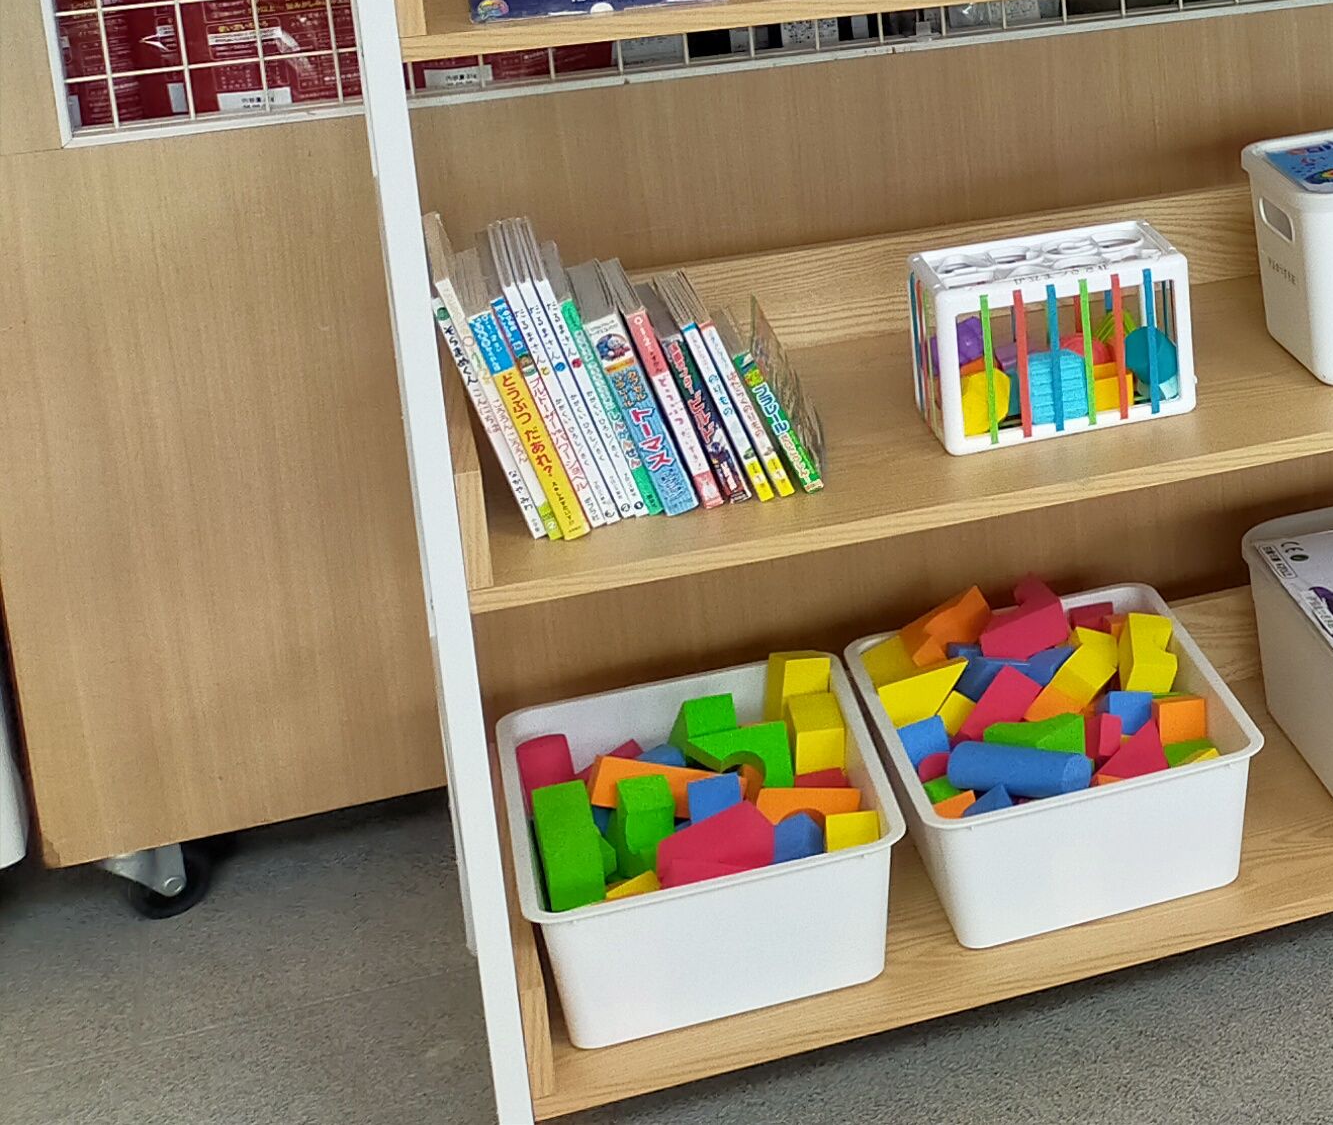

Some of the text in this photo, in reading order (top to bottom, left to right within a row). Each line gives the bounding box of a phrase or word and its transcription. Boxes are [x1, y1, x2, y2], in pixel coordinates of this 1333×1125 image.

[500, 372, 532, 426] どうぶつ
[753, 383, 789, 435] プラレール
[629, 404, 671, 472] トーマス
